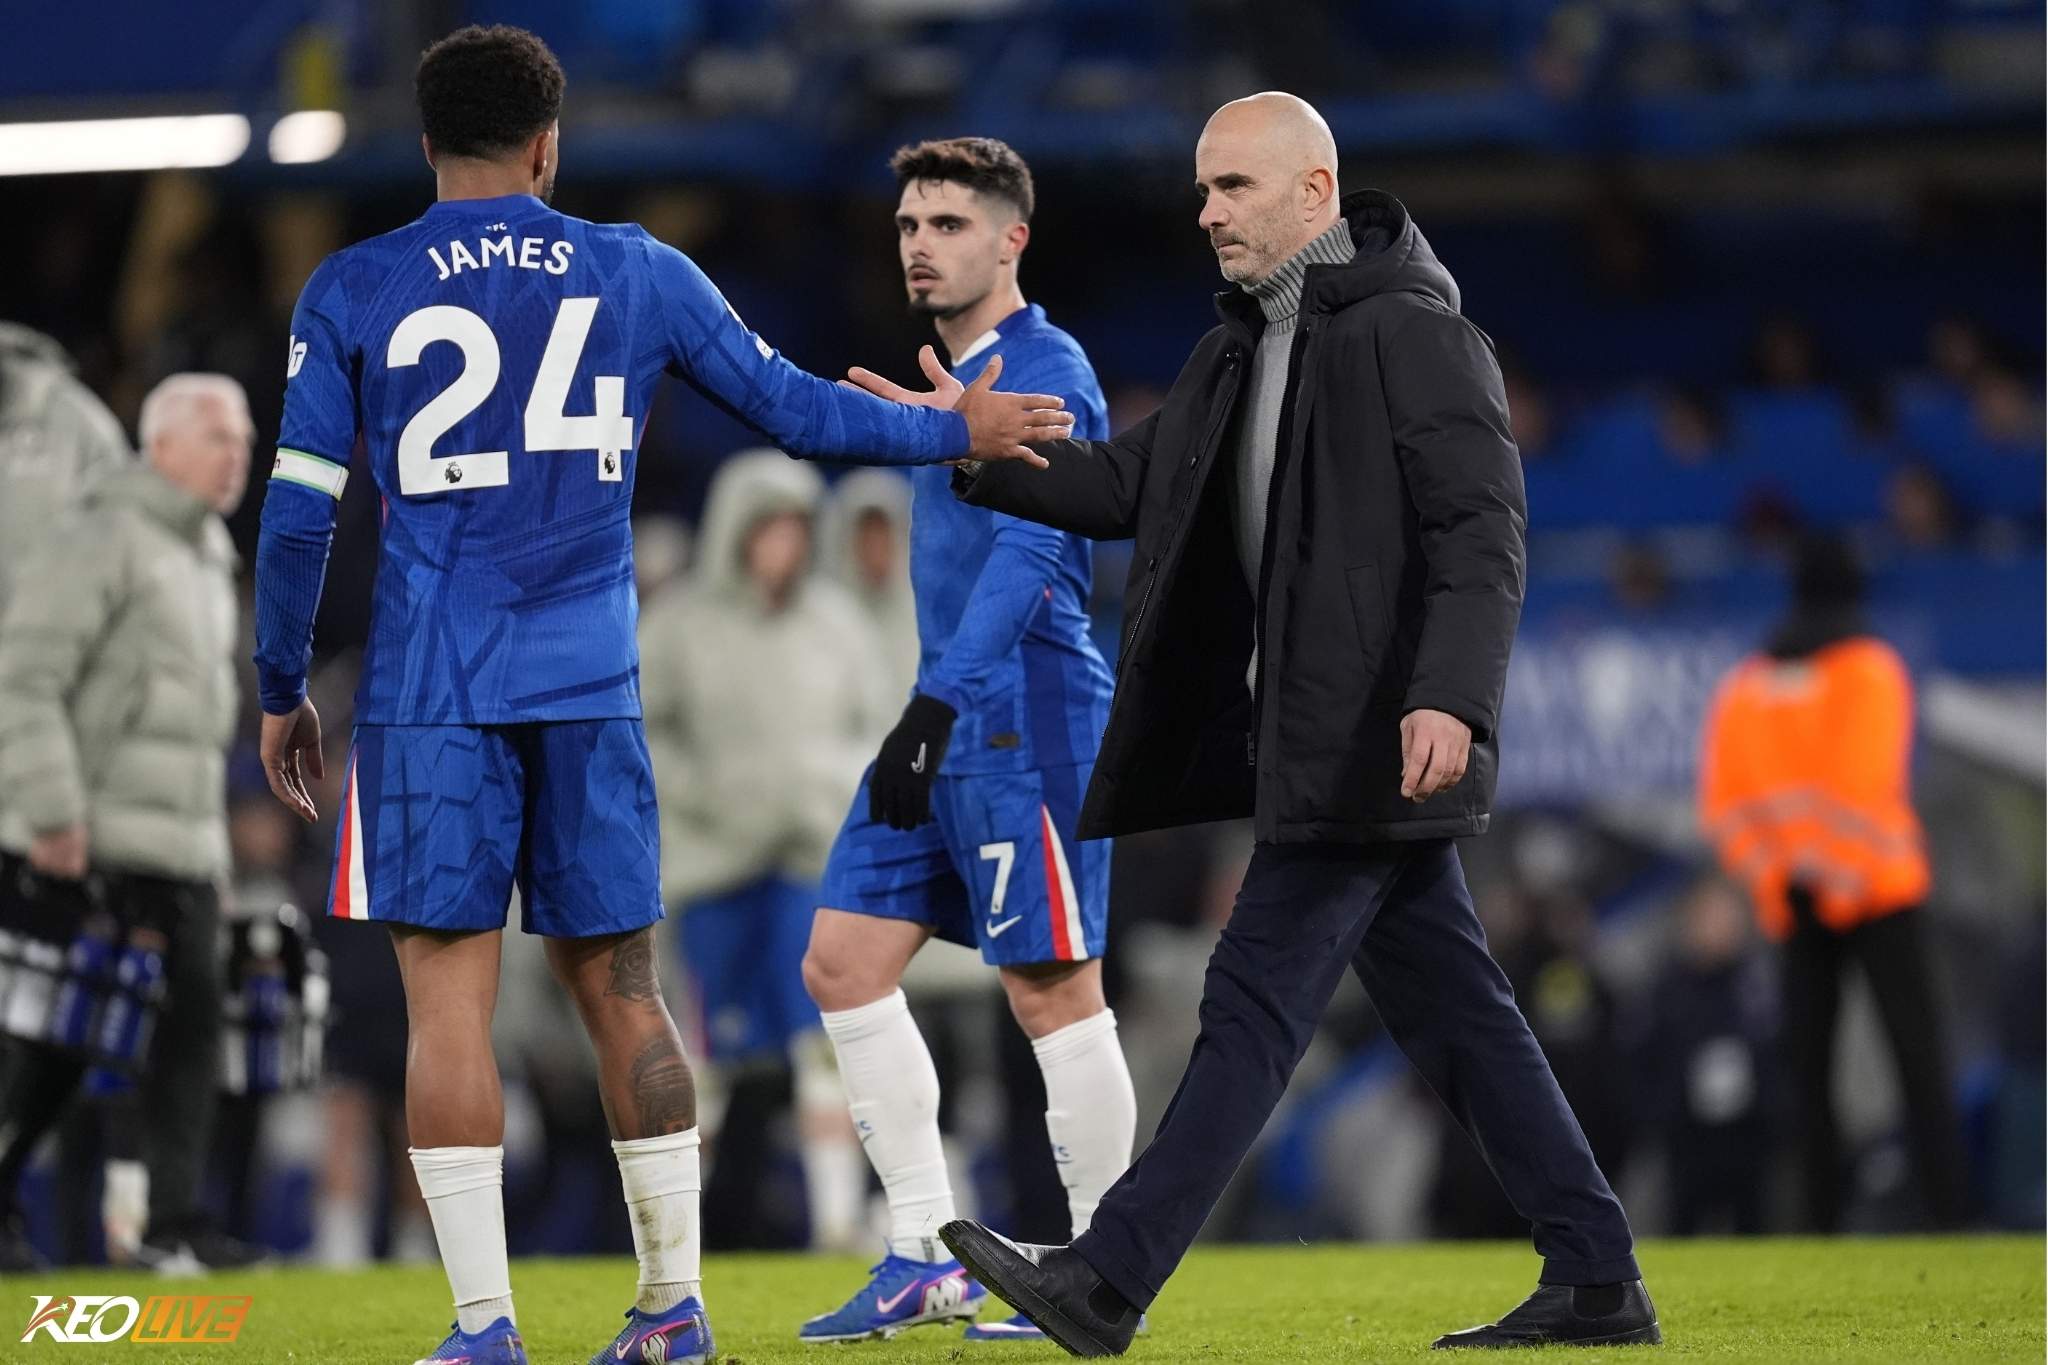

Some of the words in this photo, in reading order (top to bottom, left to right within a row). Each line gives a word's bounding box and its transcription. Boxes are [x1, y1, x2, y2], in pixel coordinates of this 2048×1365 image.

[428, 235, 573, 280] JAMES
[387, 297, 633, 495] 24
[979, 841, 1015, 914] 7
